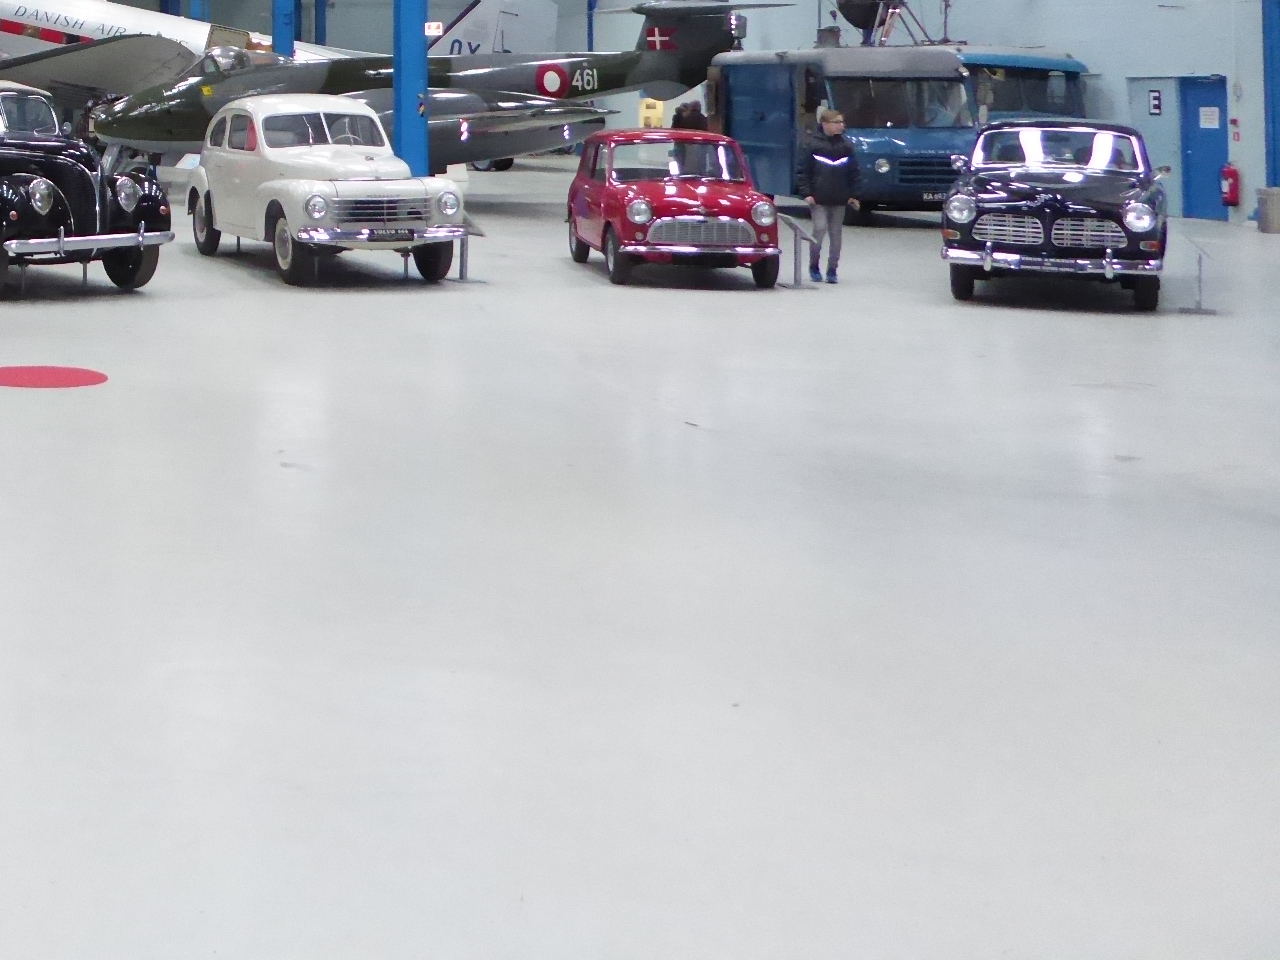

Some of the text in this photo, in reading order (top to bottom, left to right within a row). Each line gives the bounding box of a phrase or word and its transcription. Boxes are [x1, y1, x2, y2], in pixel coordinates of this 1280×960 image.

[13, 5, 127, 37] DANISH AIR
[571, 68, 598, 91] 461
